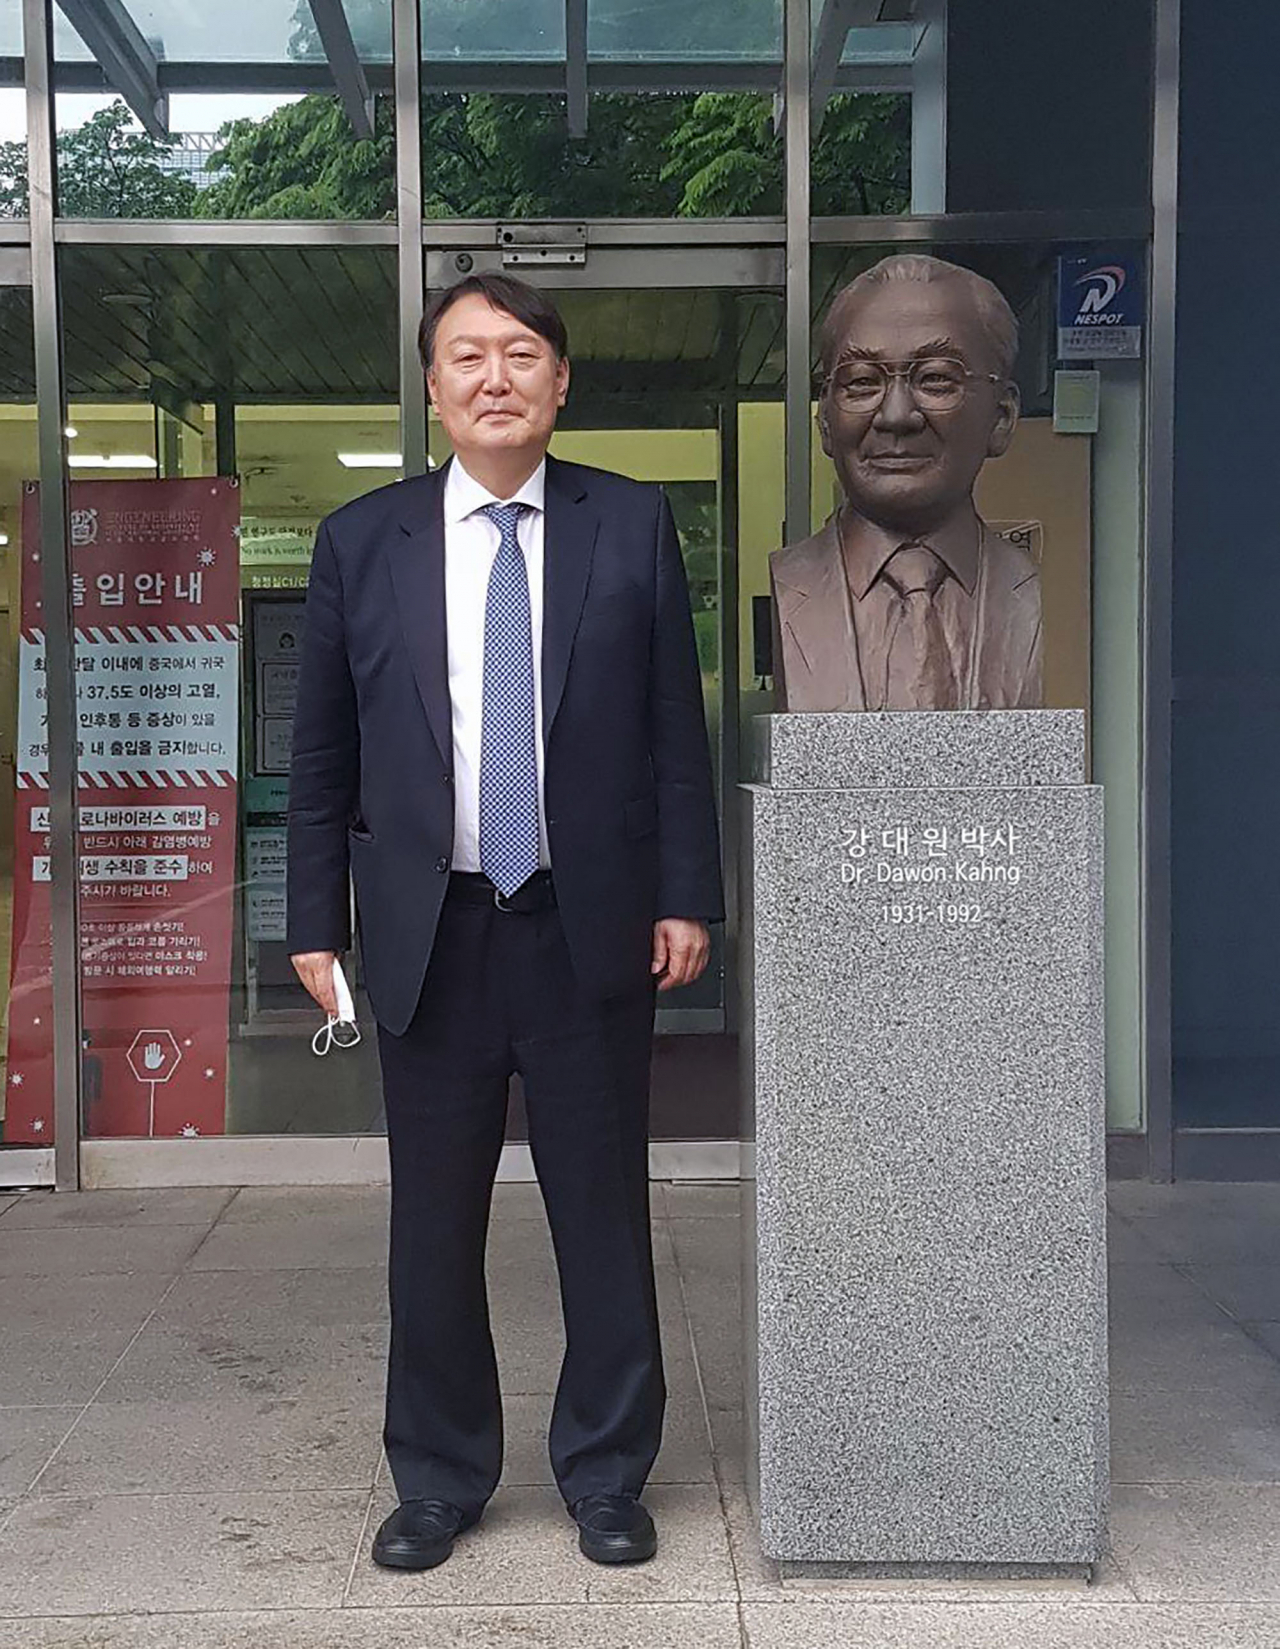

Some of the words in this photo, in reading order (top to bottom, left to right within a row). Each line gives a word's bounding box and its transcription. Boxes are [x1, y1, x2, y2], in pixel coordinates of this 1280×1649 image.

[1073, 313, 1125, 325] NESPOT
[101, 656, 143, 672] 이내에
[148, 656, 197, 671] 중국에서
[200, 656, 225, 670] 귀국
[87, 685, 134, 700] 37.5도
[139, 683, 181, 700] 이상의
[80, 712, 121, 729] 인후통
[127, 711, 141, 728] 등
[146, 711, 187, 728] 증상이
[191, 712, 215, 727] 있을
[91, 741, 105, 756] 내
[110, 740, 153, 756] 출입을
[157, 740, 226, 756] 금지합니다.
[37, 811, 167, 827] 신로나바이러스
[83, 836, 119, 850] 반드시
[123, 836, 147, 850] 아래
[841, 828, 870, 858] 강
[881, 827, 909, 857] 대
[921, 826, 949, 857] 원
[961, 824, 1022, 856] 박사
[104, 859, 148, 875] 수칙을
[841, 864, 869, 884] Dr.
[876, 863, 947, 884] Dawon
[954, 861, 1021, 886] Kahng
[81, 884, 116, 898] 주시기
[880, 904, 982, 925] 1931-1992
